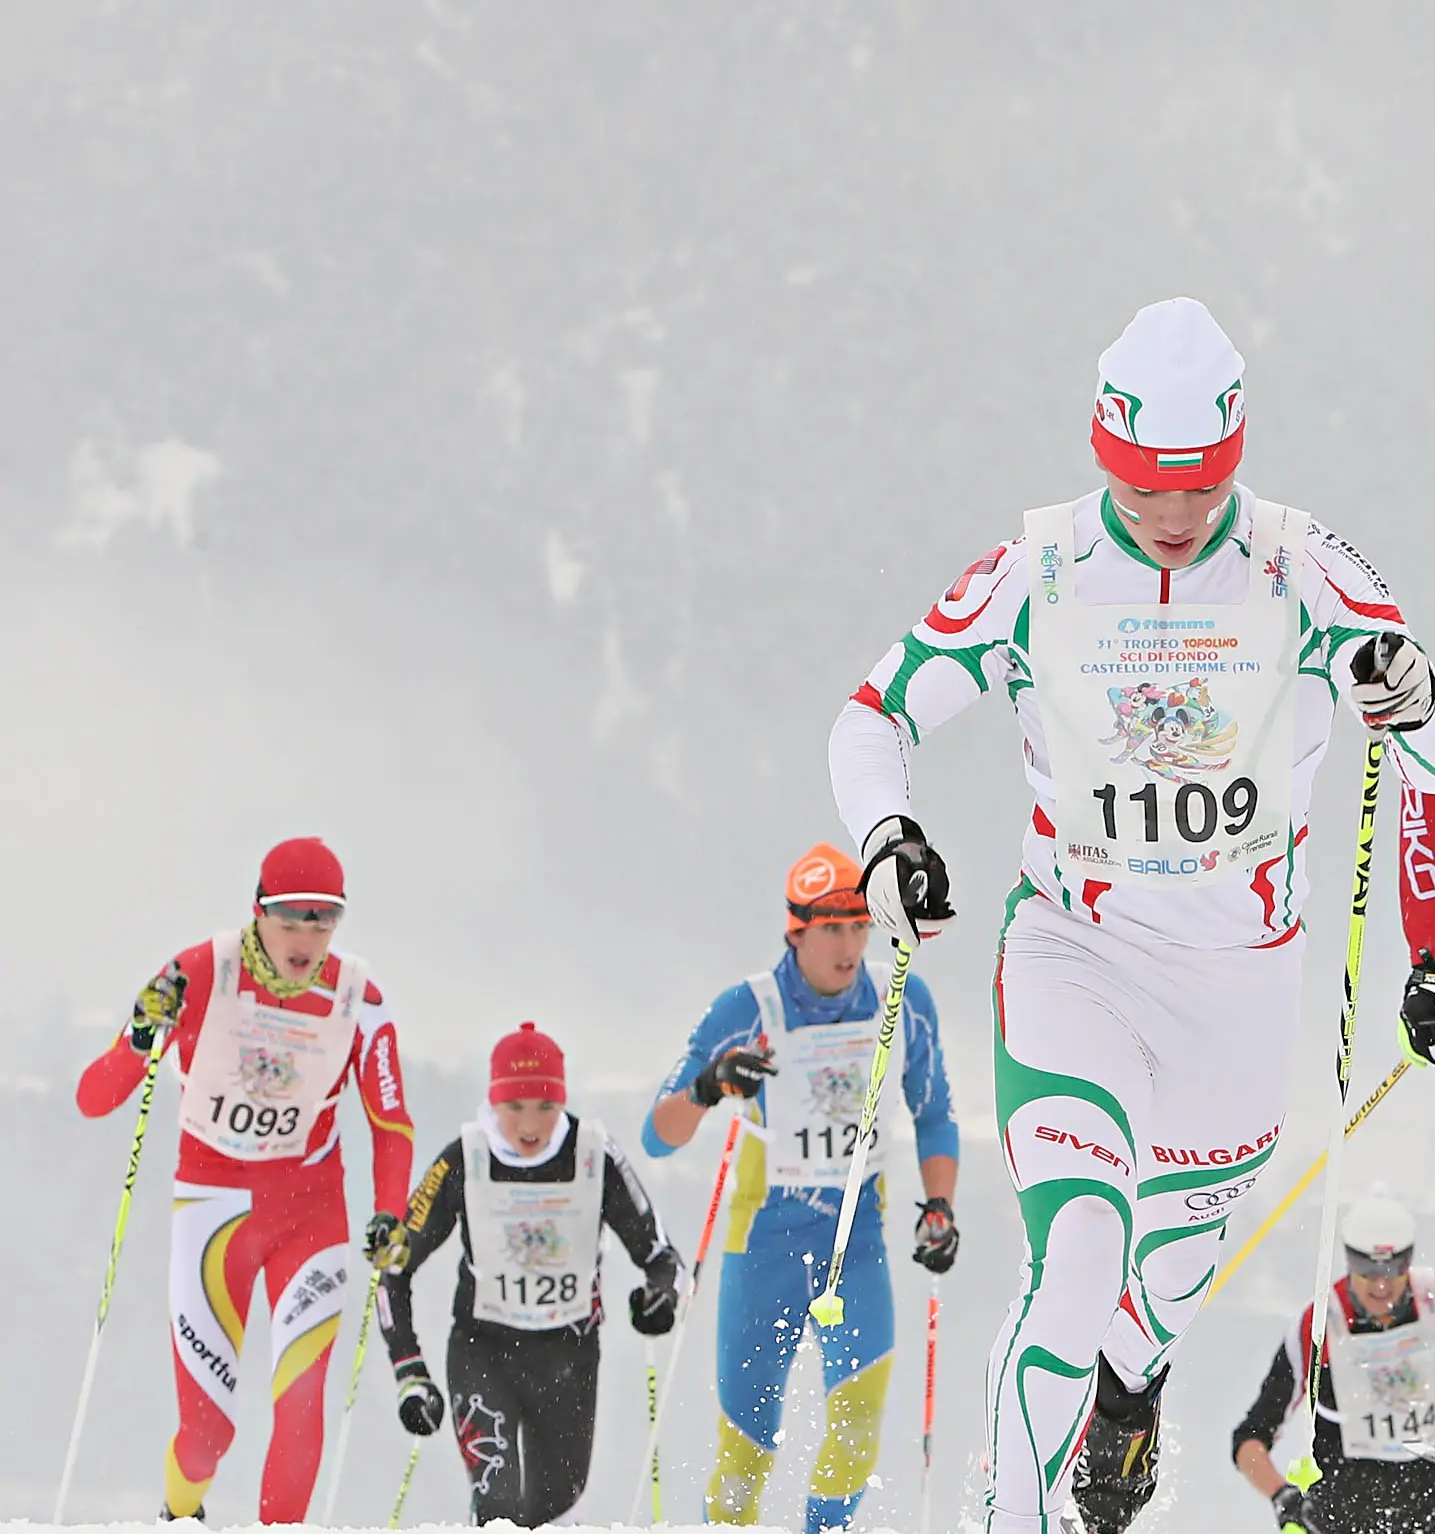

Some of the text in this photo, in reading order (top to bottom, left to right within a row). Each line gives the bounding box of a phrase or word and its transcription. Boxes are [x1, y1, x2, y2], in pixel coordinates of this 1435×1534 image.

[1041, 543, 1058, 604] TRENTINO
[1119, 650, 1219, 663] SCI DI FONDO
[1124, 638, 1179, 649] TROFEO
[1182, 636, 1239, 649] TOPOLINO
[1080, 660, 1261, 675] CASTELLO DI FIEMME (TN)
[1093, 777, 1258, 842] 1109
[1082, 845, 1109, 859] ITAS
[1127, 857, 1198, 875] BAILO
[375, 1034, 401, 1111] sportful
[209, 1095, 301, 1137] 1093
[1151, 1124, 1280, 1166] BULGARI
[1188, 1207, 1225, 1222] Audi
[496, 1274, 578, 1306] 1128
[177, 1314, 238, 1393] sportful
[1360, 1402, 1435, 1439] 1144
